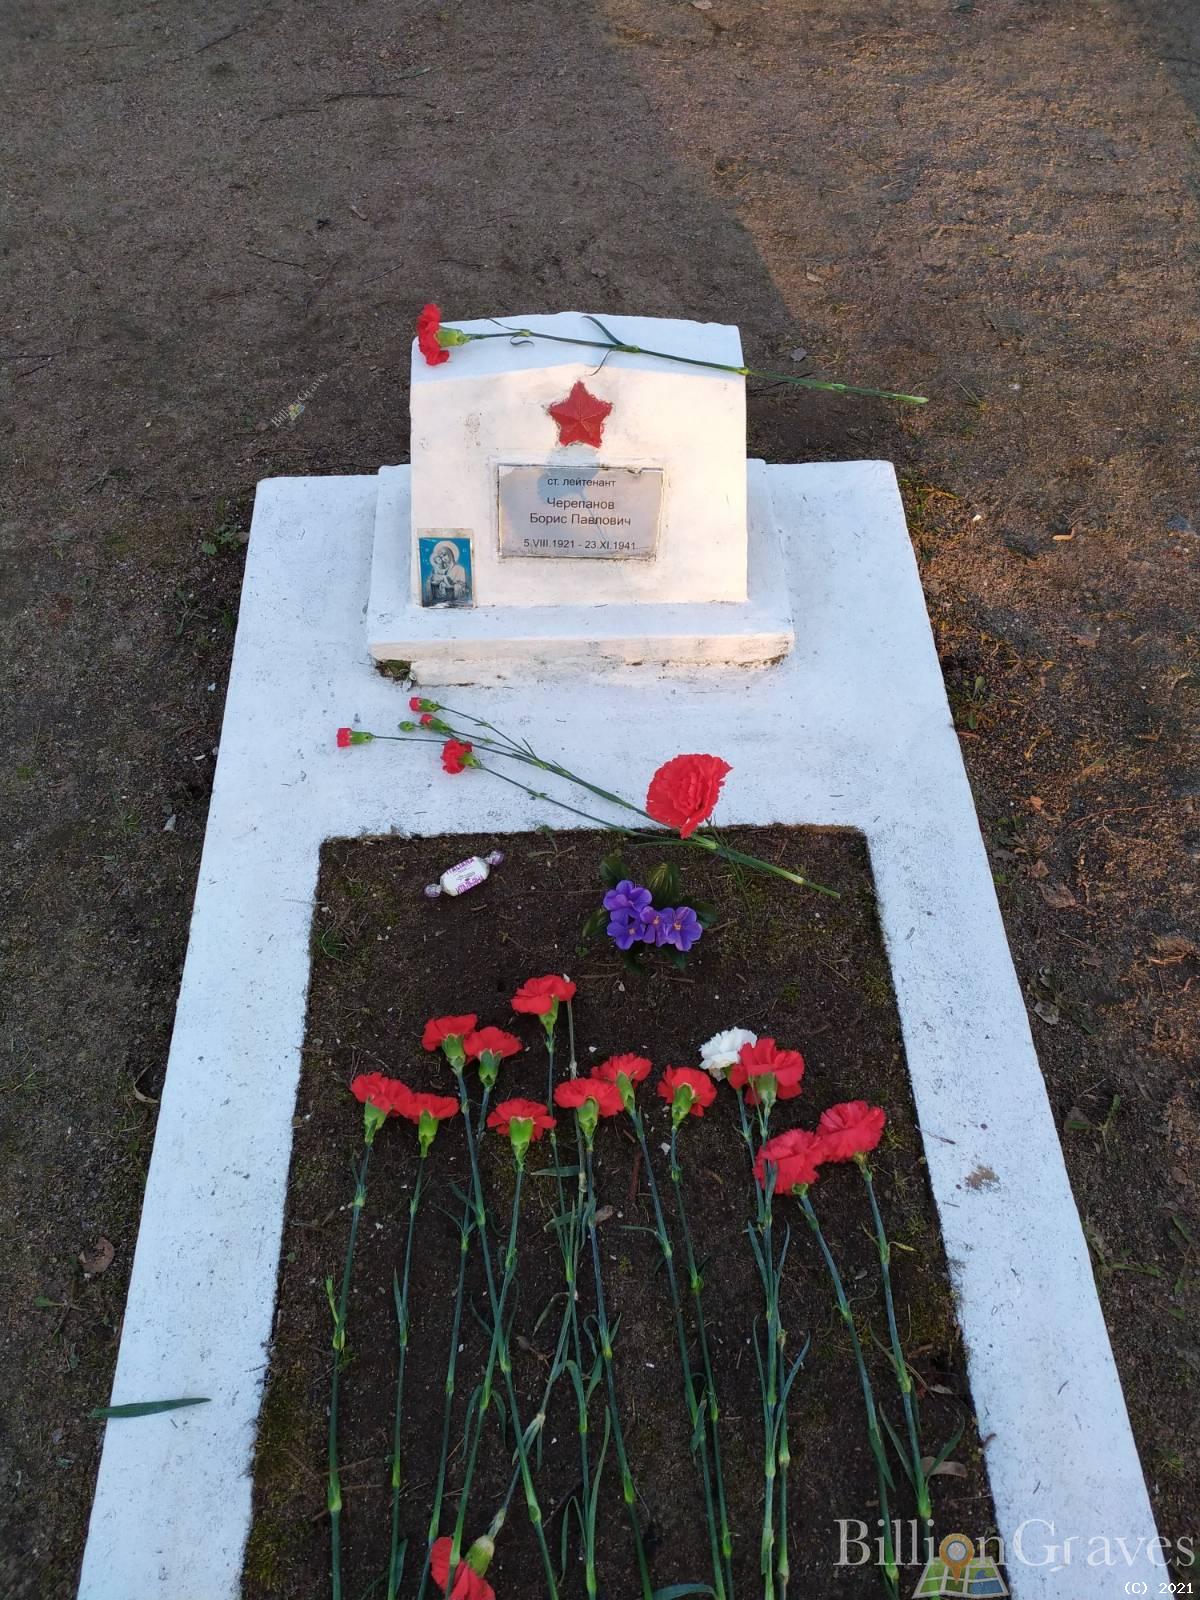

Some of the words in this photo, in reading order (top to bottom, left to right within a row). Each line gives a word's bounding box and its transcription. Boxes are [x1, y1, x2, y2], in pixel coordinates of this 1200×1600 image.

[547, 478, 560, 487] ст.
[562, 477, 616, 488] лейтенант
[547, 497, 615, 511] Черепанов
[529, 513, 568, 526] Борис
[571, 513, 631, 527] Павлович
